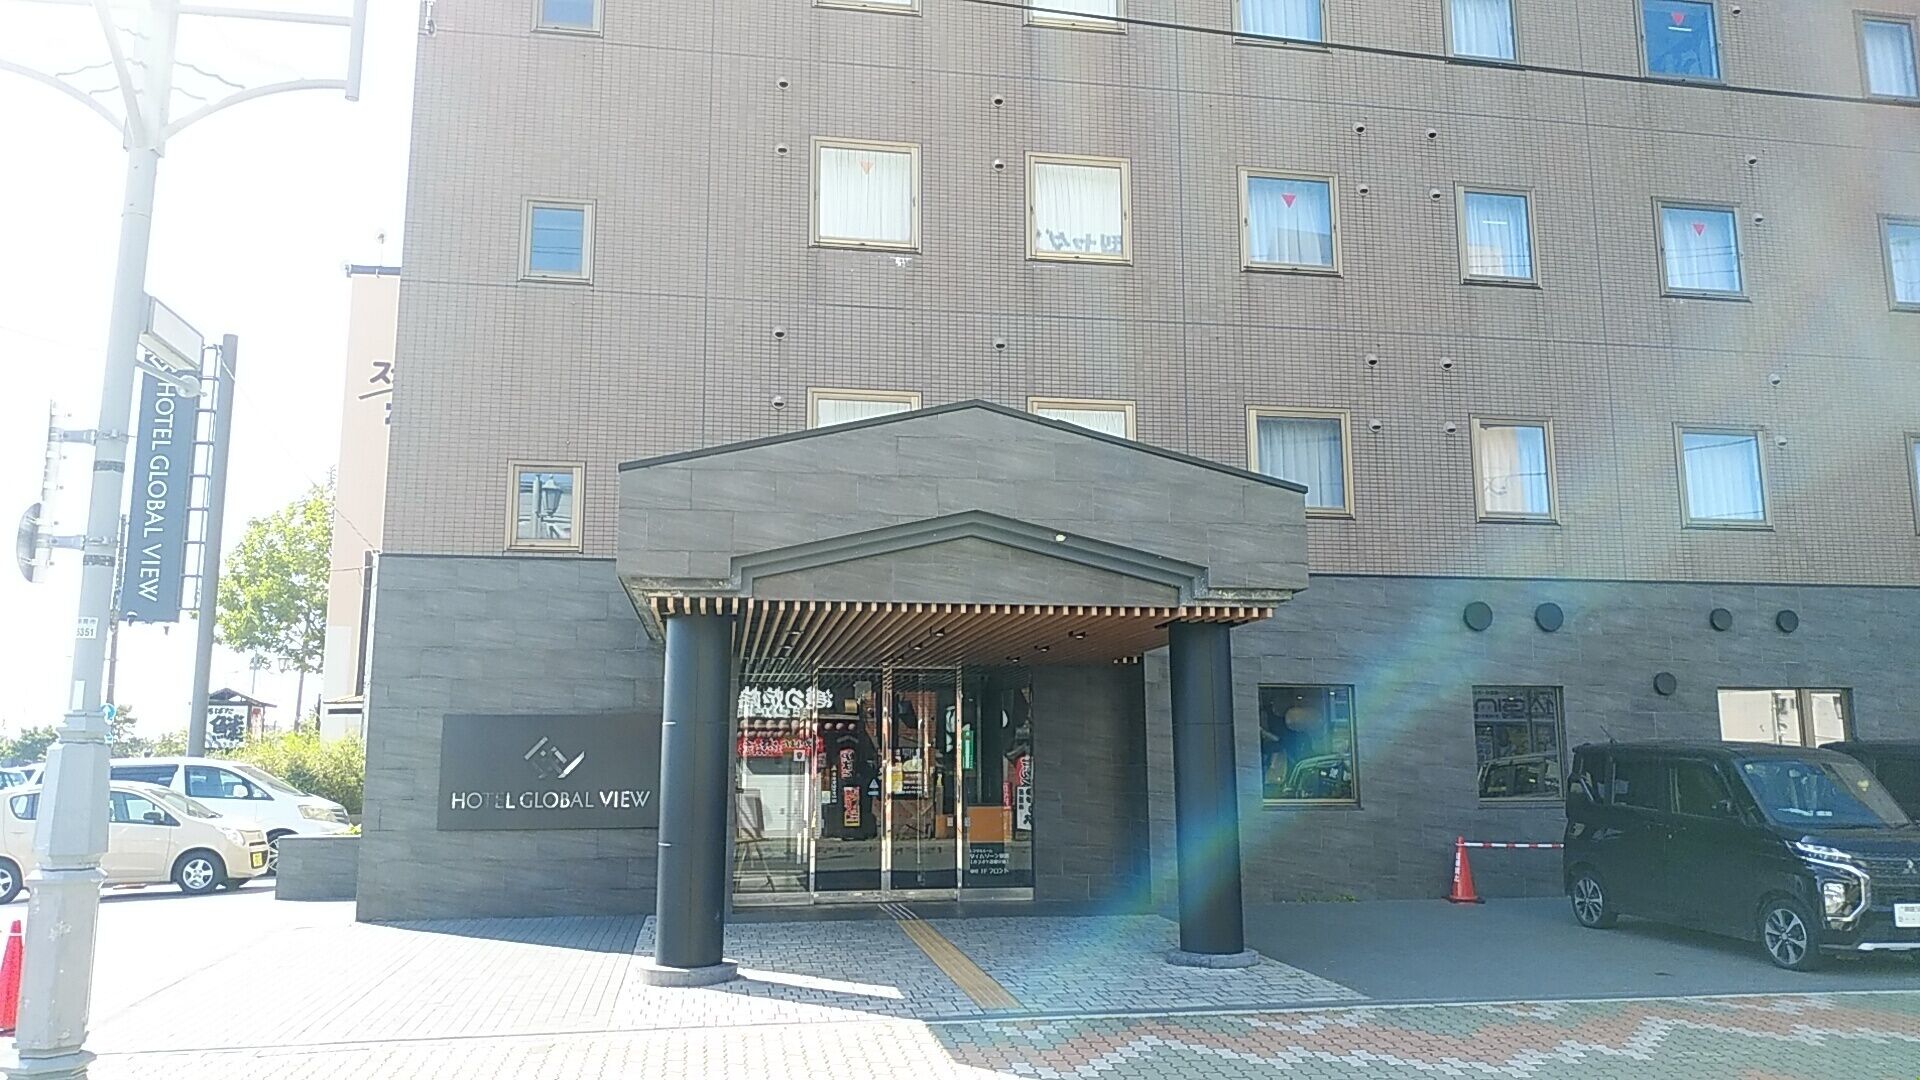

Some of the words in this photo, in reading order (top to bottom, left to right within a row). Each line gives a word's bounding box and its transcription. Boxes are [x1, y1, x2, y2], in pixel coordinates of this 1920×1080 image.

[369, 361, 394, 385] ス
[151, 382, 176, 451] HOTEL
[143, 455, 170, 538] GLOBAL
[138, 543, 163, 602] VIEW
[451, 792, 516, 810] HOTEL
[519, 791, 594, 809] GLOBAL
[599, 790, 651, 809] VIEW
